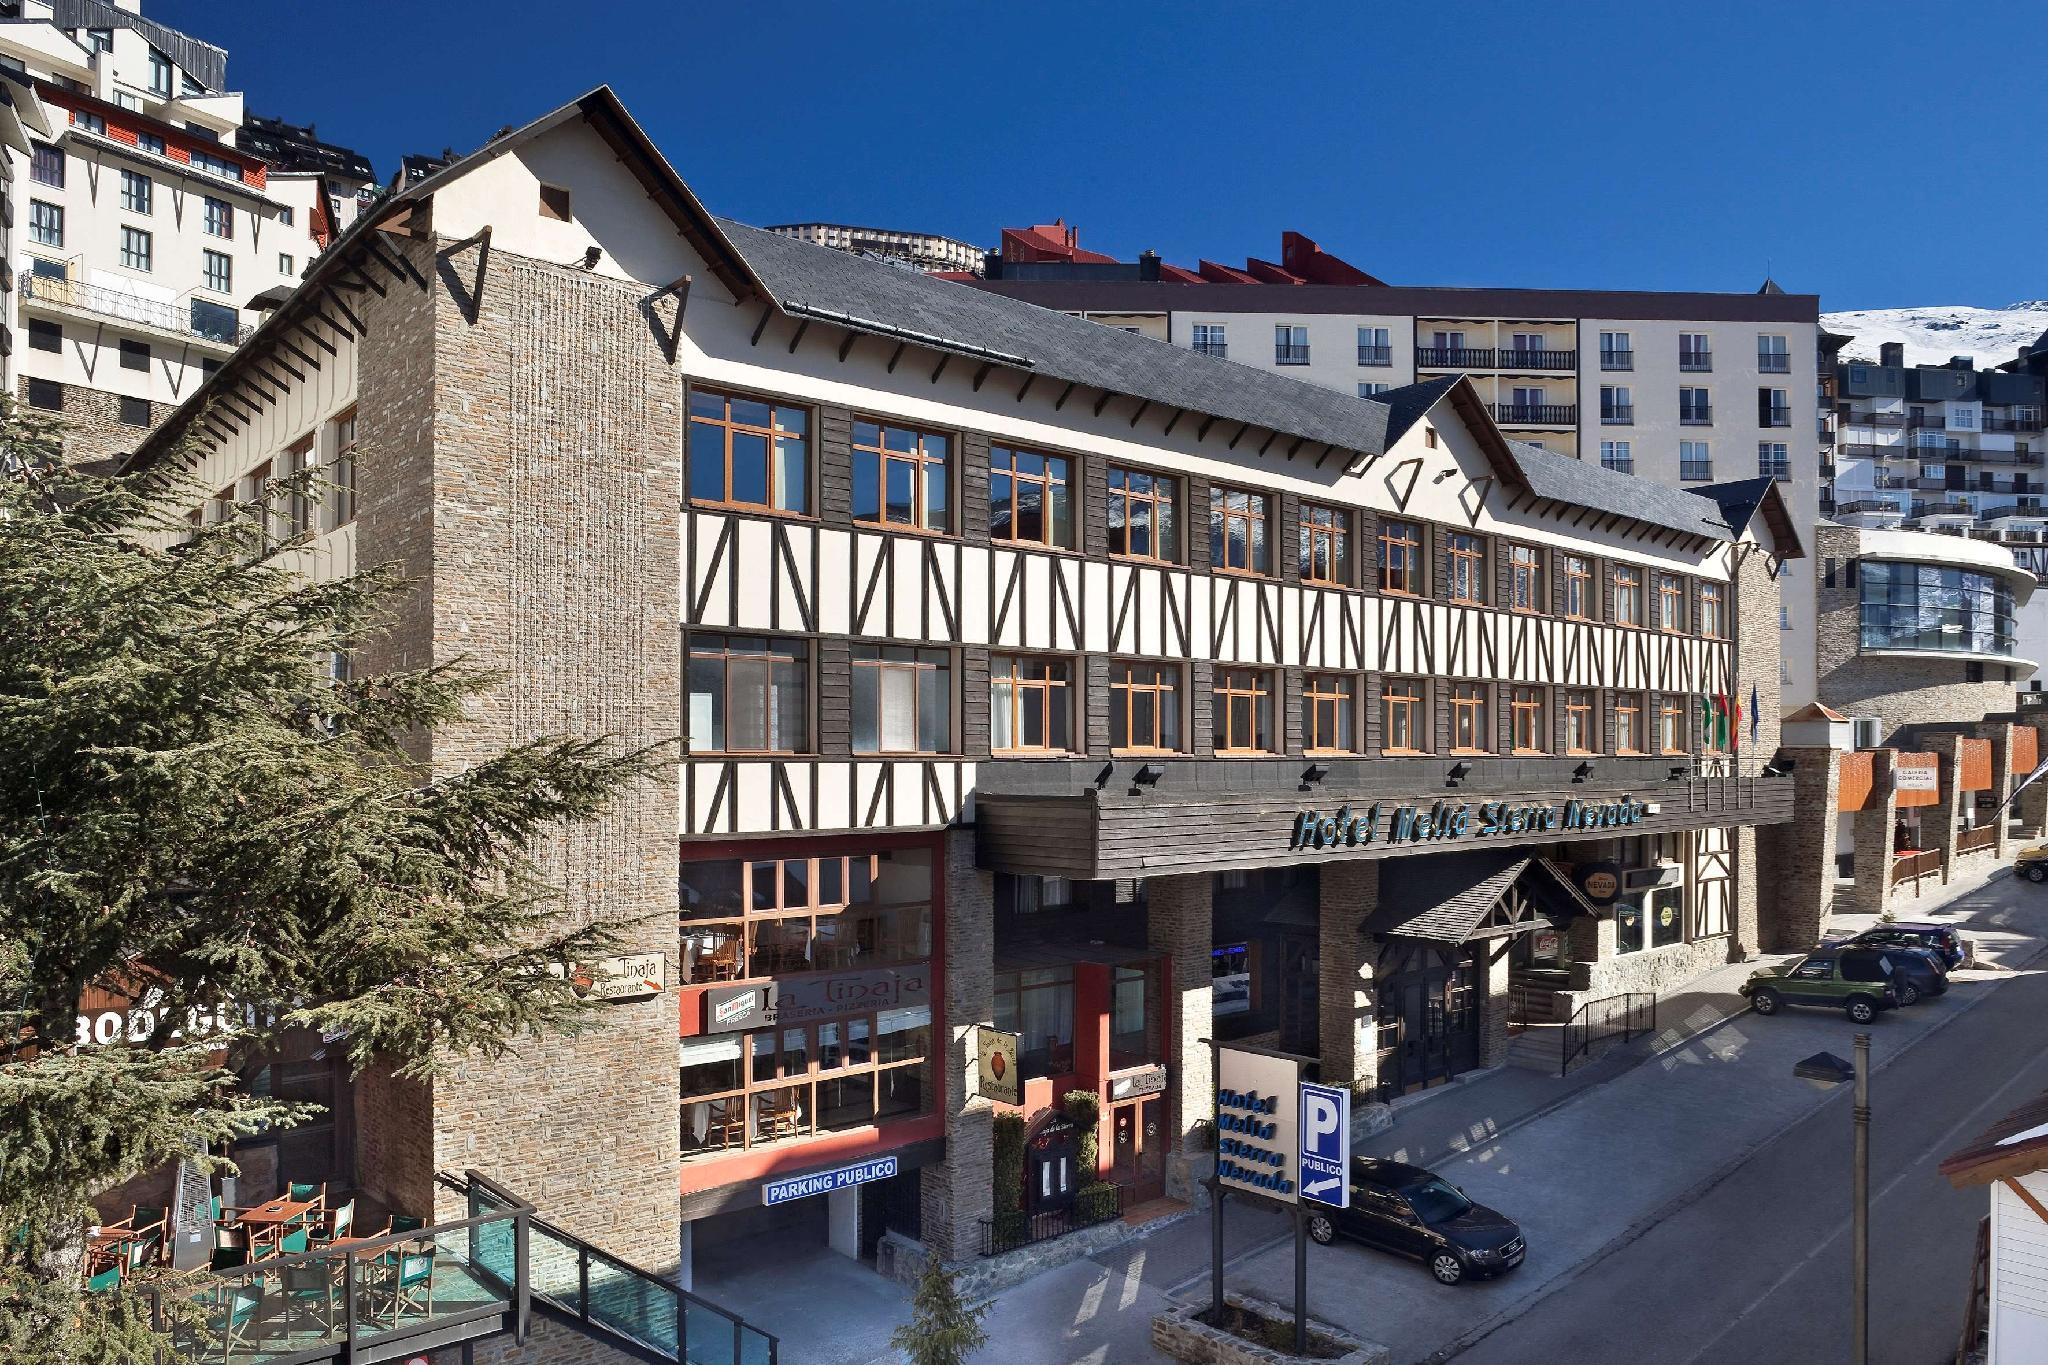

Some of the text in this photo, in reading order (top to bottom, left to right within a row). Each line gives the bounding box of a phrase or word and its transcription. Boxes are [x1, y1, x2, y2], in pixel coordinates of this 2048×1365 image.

[1295, 802, 1381, 846] Hotel
[1479, 801, 1557, 834] Sierra
[1566, 793, 1643, 828] Nevada
[1587, 881, 1615, 889] NEVADA
[618, 958, 656, 978] Tinaja
[761, 974, 923, 1012] La Tinaja
[980, 1075, 1017, 1097] Restaurante
[1217, 1088, 1277, 1115] Hotel
[1306, 1095, 1338, 1152] P
[1219, 1138, 1285, 1167] Sierra
[1302, 1158, 1342, 1175] PUBLICO
[770, 1161, 894, 1200] PARKING PUBLICO
[1217, 1159, 1295, 1194] Nevada
